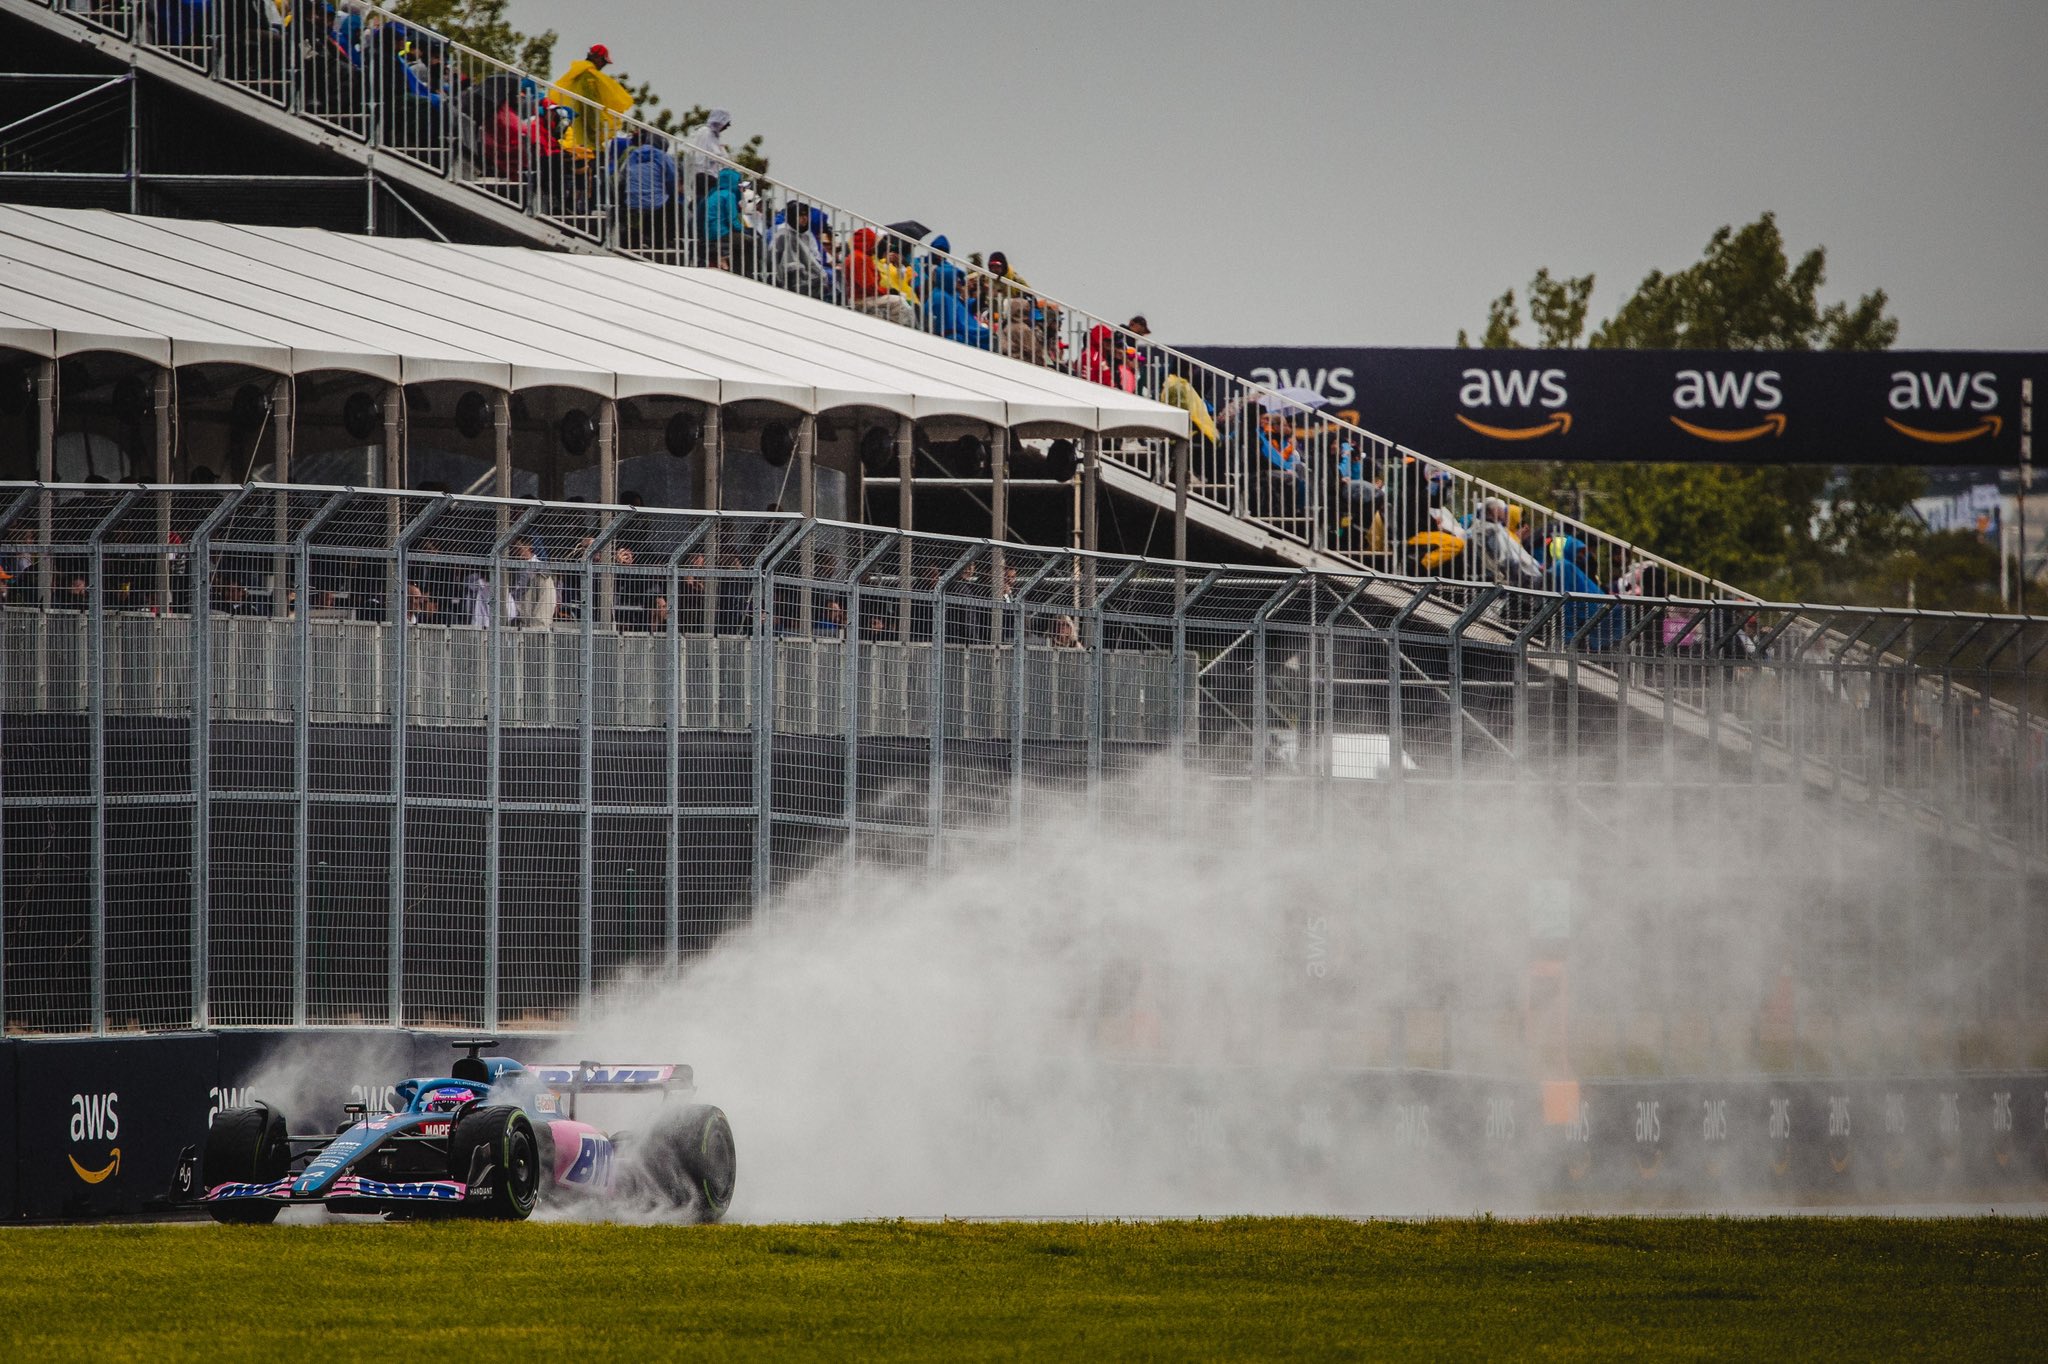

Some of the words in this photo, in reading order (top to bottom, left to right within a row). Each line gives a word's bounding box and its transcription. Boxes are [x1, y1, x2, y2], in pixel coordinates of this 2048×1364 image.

[1459, 368, 1568, 407] aws
[1673, 370, 1783, 410] aws
[1888, 371, 1998, 410] aws
[1306, 917, 1327, 977] aws
[71, 1092, 119, 1141] aws
[1635, 1100, 1659, 1142] aws
[1702, 1099, 1725, 1140] aws
[1769, 1098, 1789, 1138] aws
[1827, 1095, 1849, 1136] aws
[1992, 1091, 2011, 1131] aws
[359, 1179, 457, 1198] BWT
